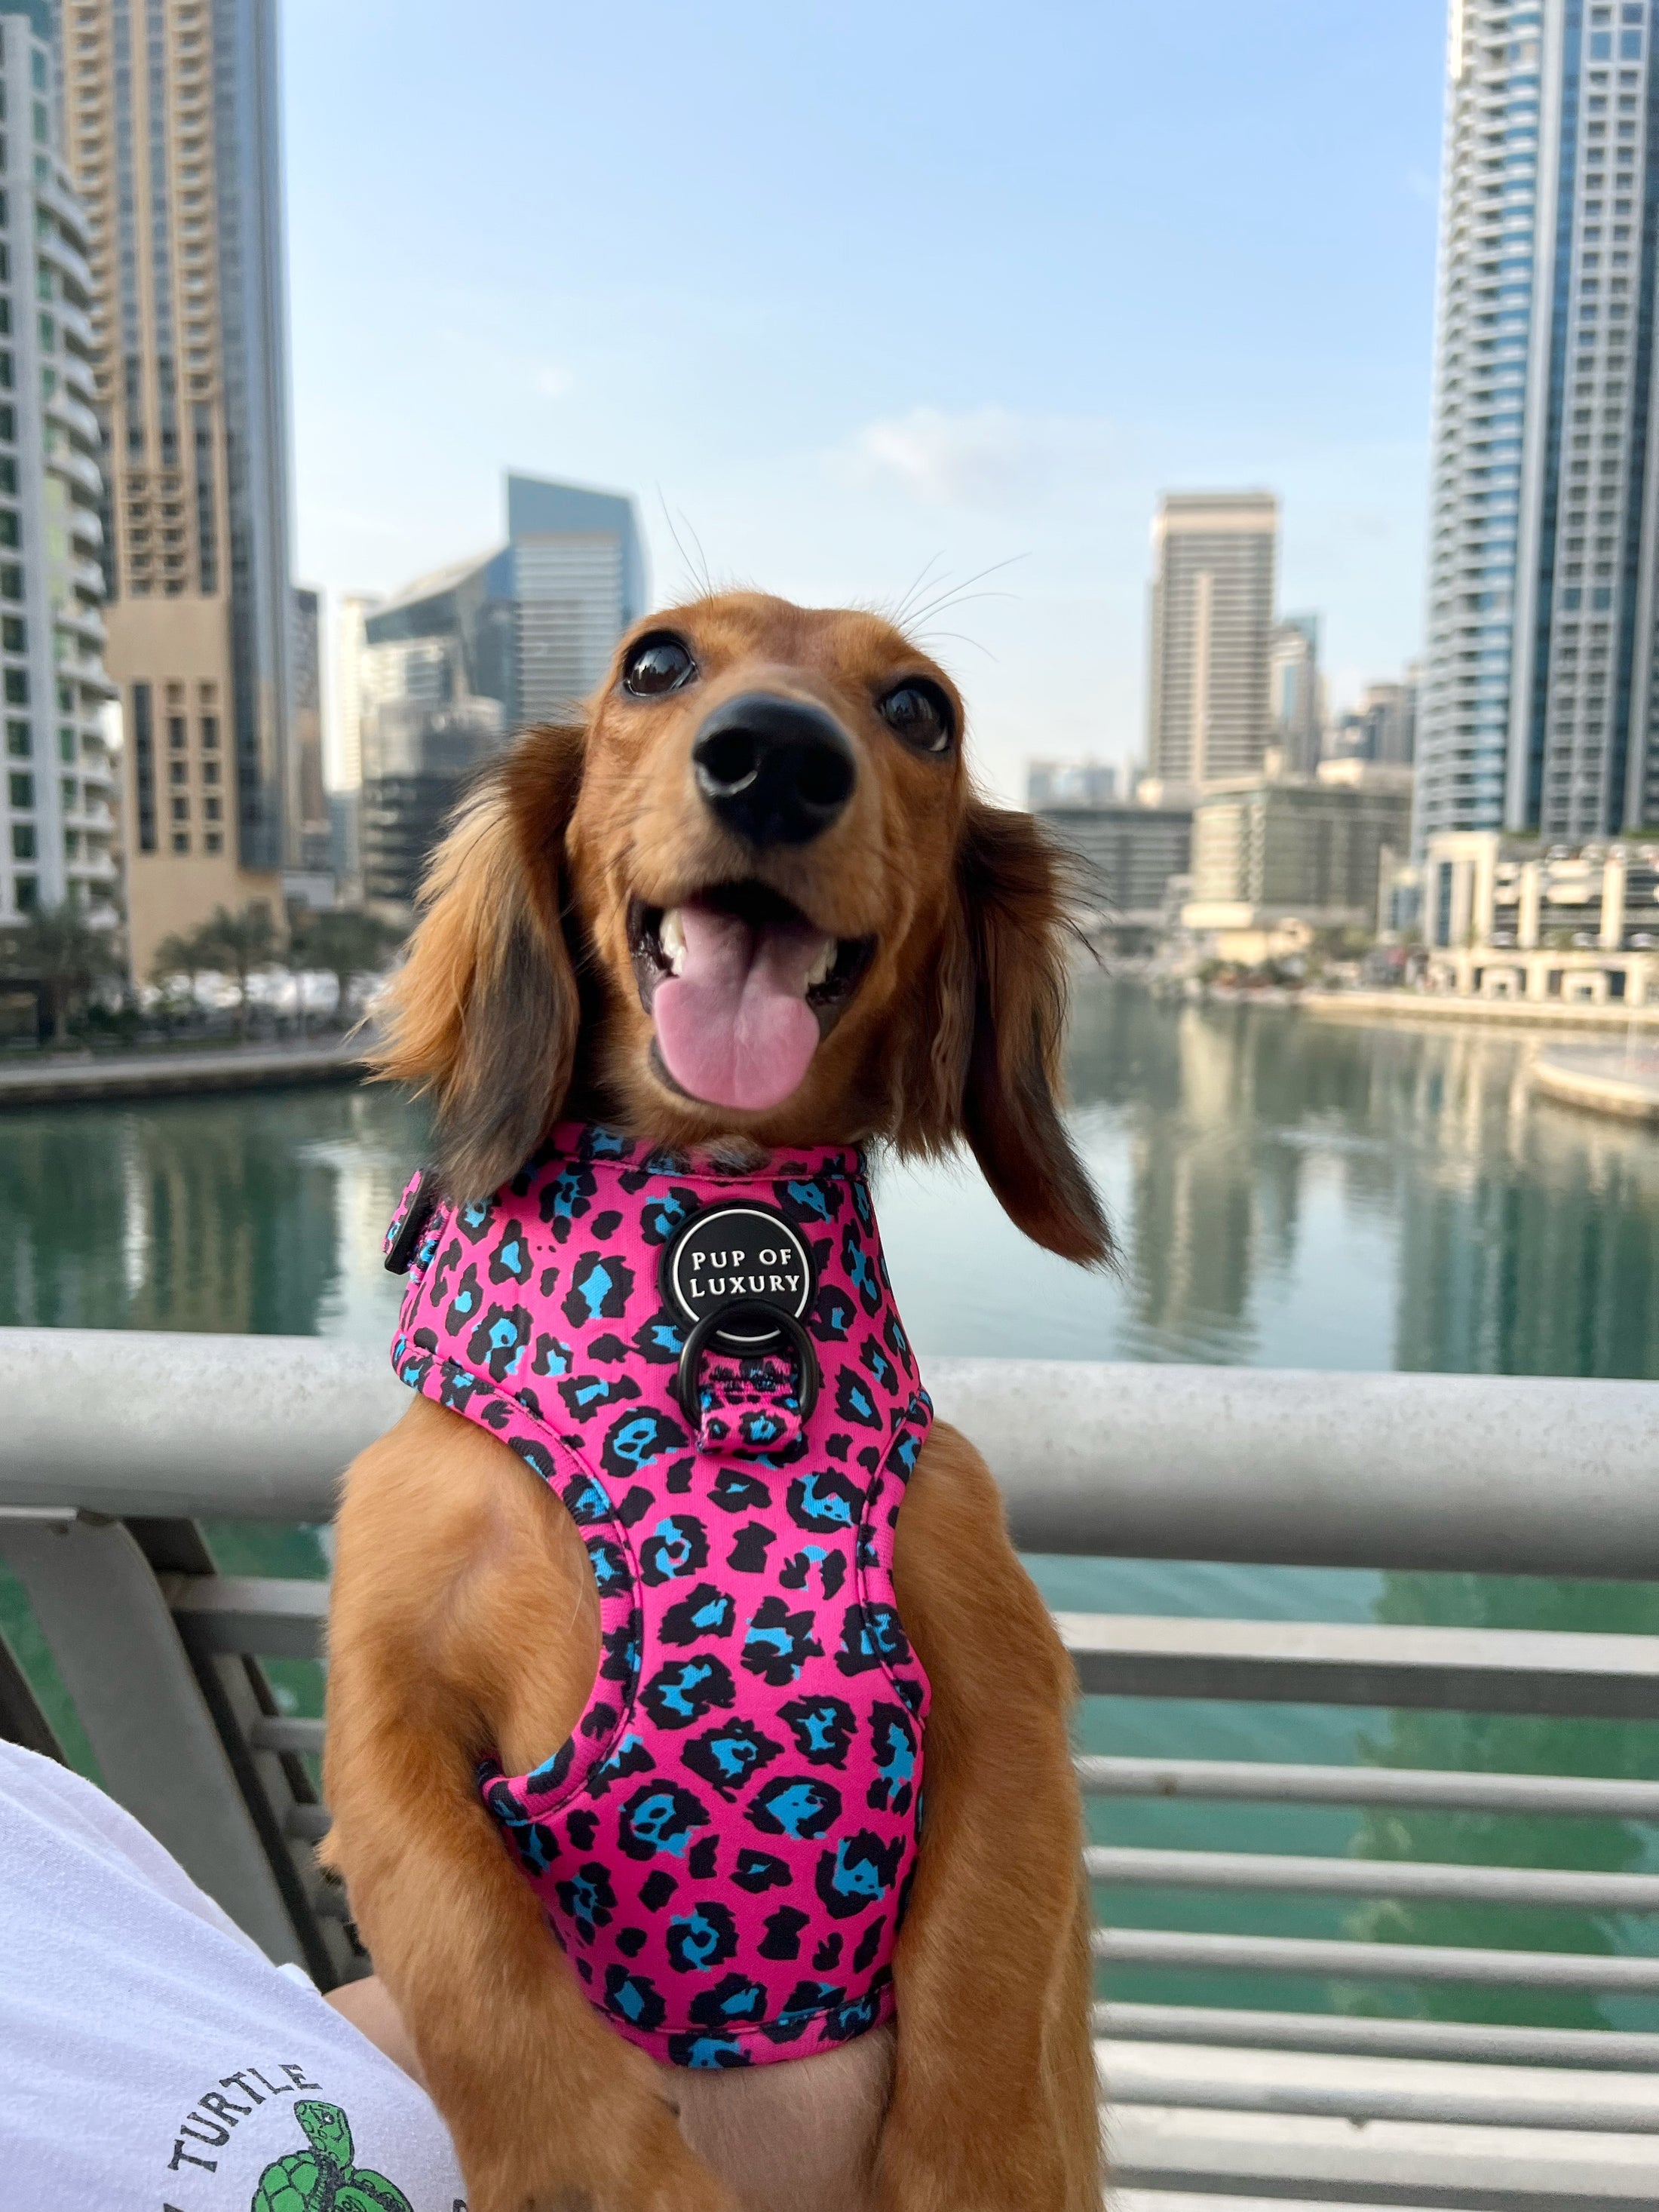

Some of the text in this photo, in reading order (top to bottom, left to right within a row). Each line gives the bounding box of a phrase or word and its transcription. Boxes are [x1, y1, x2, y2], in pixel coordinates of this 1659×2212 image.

[692, 1248, 792, 1271] PUP OF
[689, 1275, 801, 1298] LUXURY
[167, 2063, 323, 2173] TURTLE
